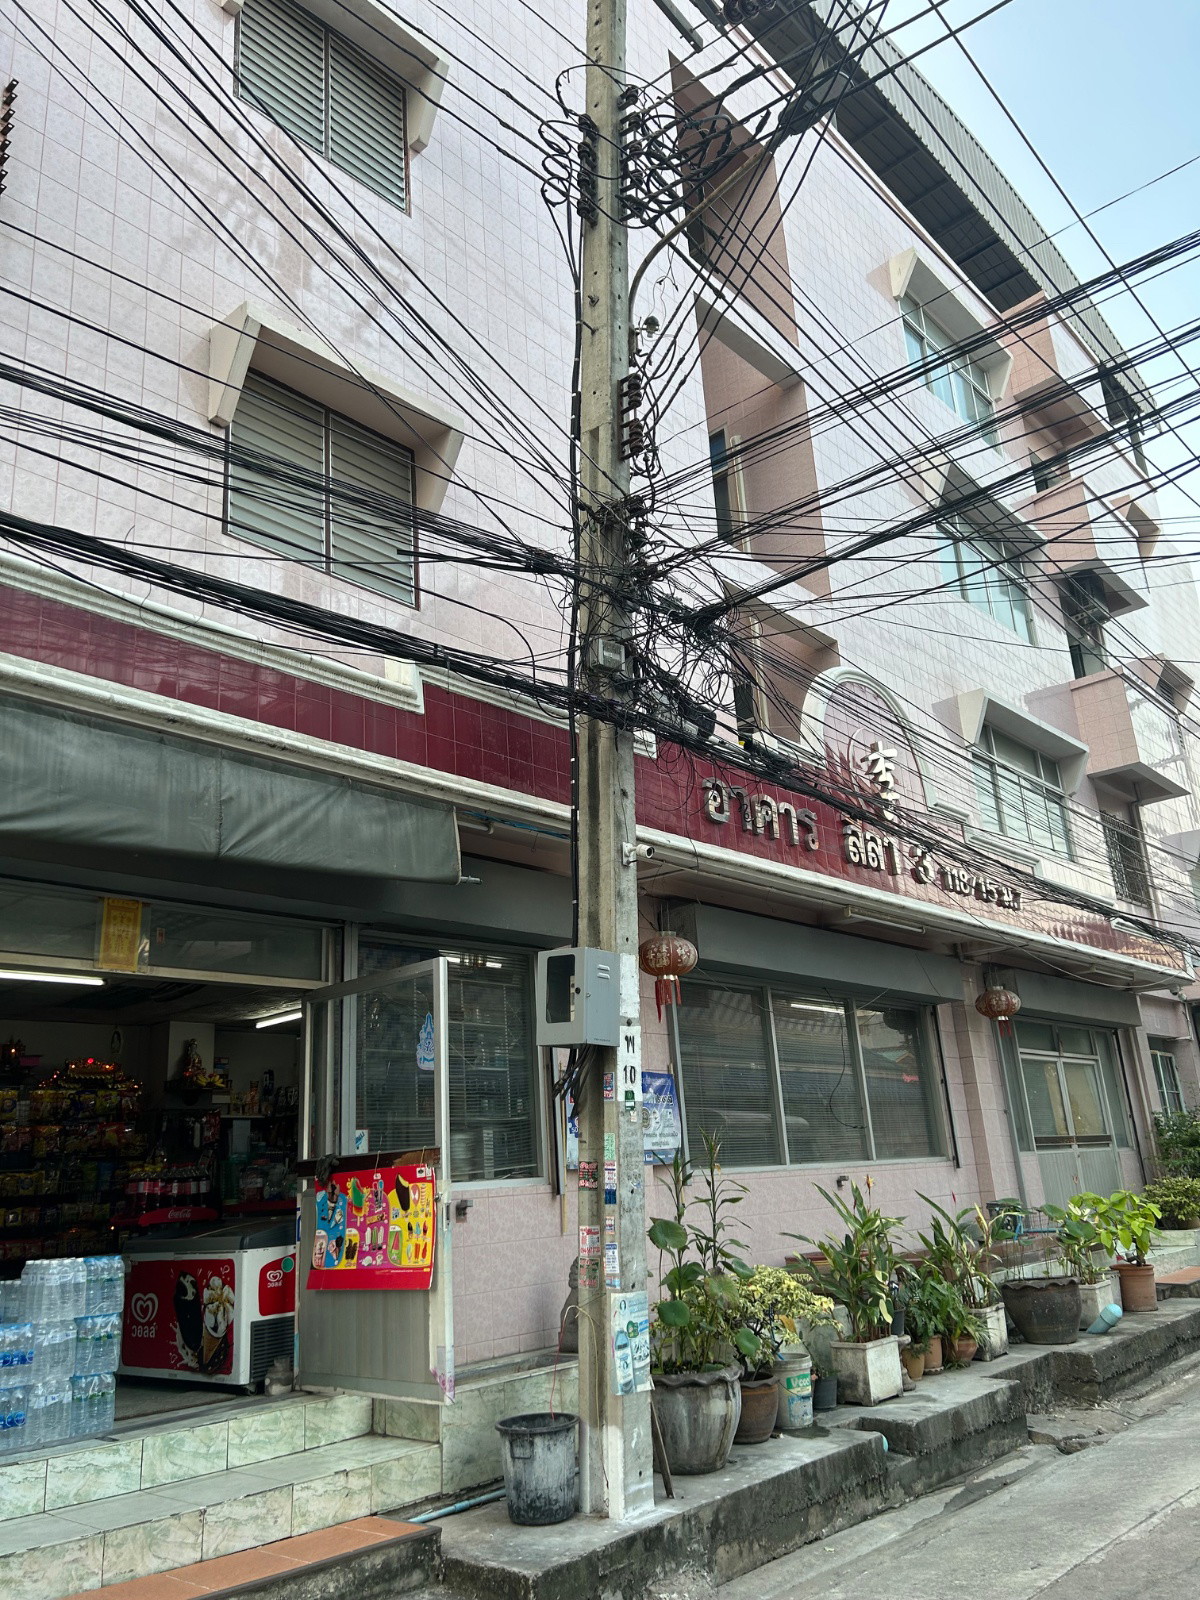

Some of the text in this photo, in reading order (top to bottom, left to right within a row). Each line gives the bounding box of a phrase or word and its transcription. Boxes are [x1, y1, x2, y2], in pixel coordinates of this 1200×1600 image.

[701, 776, 820, 852] อาคาร
[623, 1064, 637, 1085] 10
[168, 1208, 192, 1219] Coca-Cola
[131, 1322, 157, 1339] วอลล์
